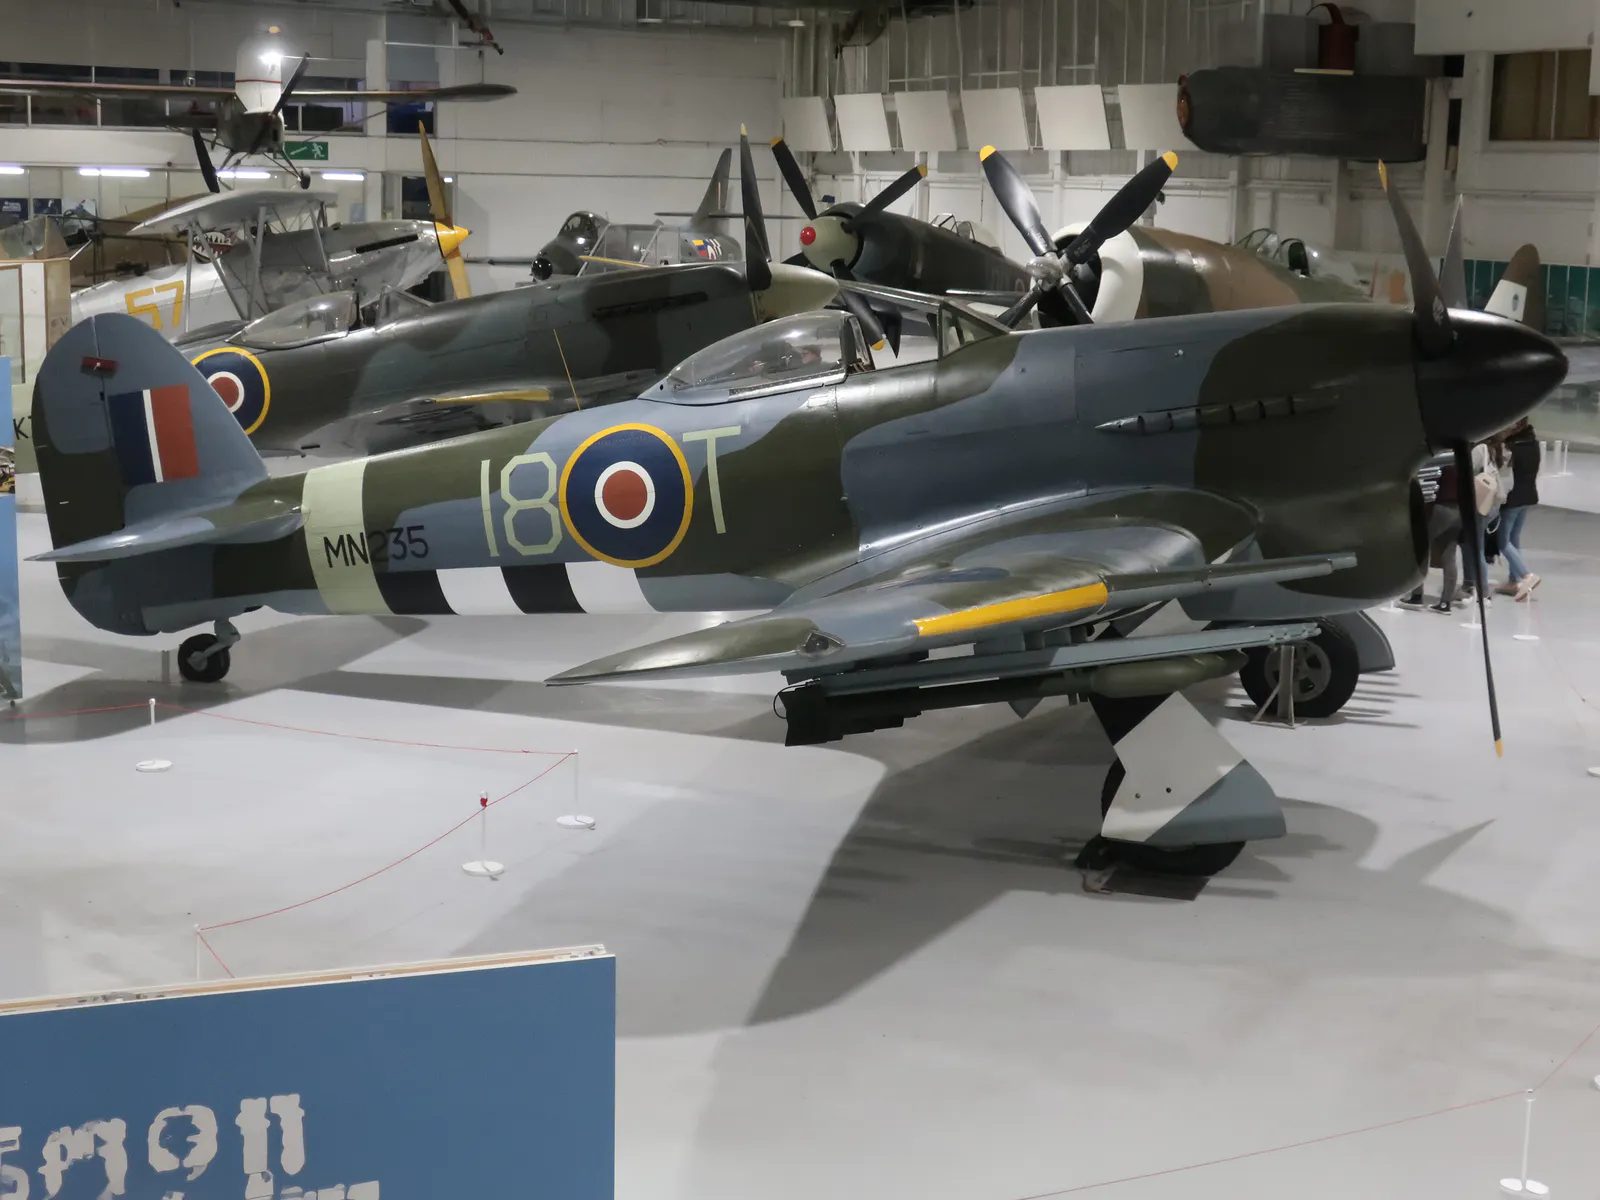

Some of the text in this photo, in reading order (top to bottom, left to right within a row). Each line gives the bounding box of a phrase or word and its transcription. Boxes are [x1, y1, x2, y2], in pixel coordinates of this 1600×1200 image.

[125, 280, 185, 331] 57
[682, 425, 742, 535] T
[323, 525, 429, 568] MN235
